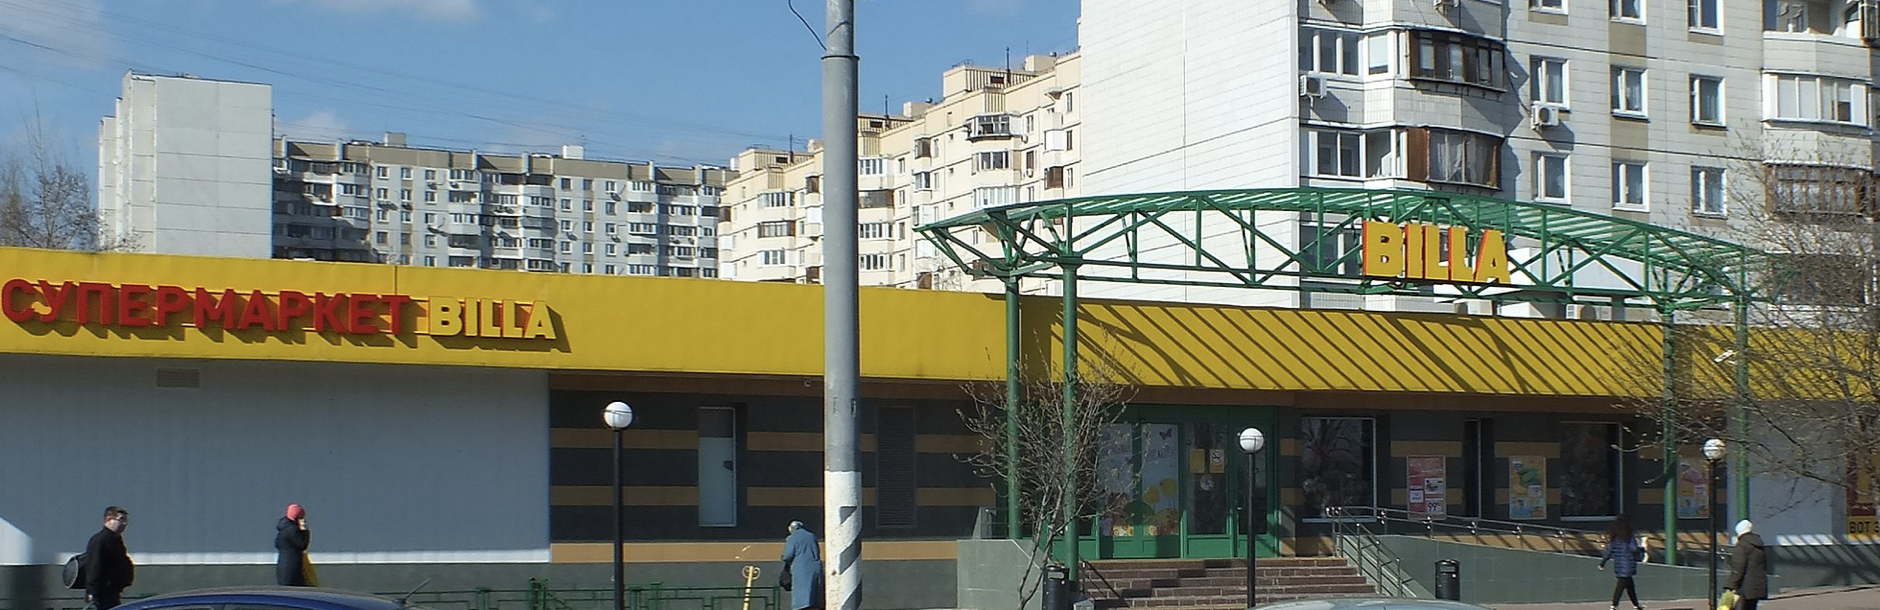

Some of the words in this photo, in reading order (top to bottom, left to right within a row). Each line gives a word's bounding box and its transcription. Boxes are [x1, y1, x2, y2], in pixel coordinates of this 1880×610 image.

[1363, 220, 1511, 284] BILLA
[1, 279, 410, 335] СУПЕРМАРКЕТ
[429, 296, 556, 339] BILLA
